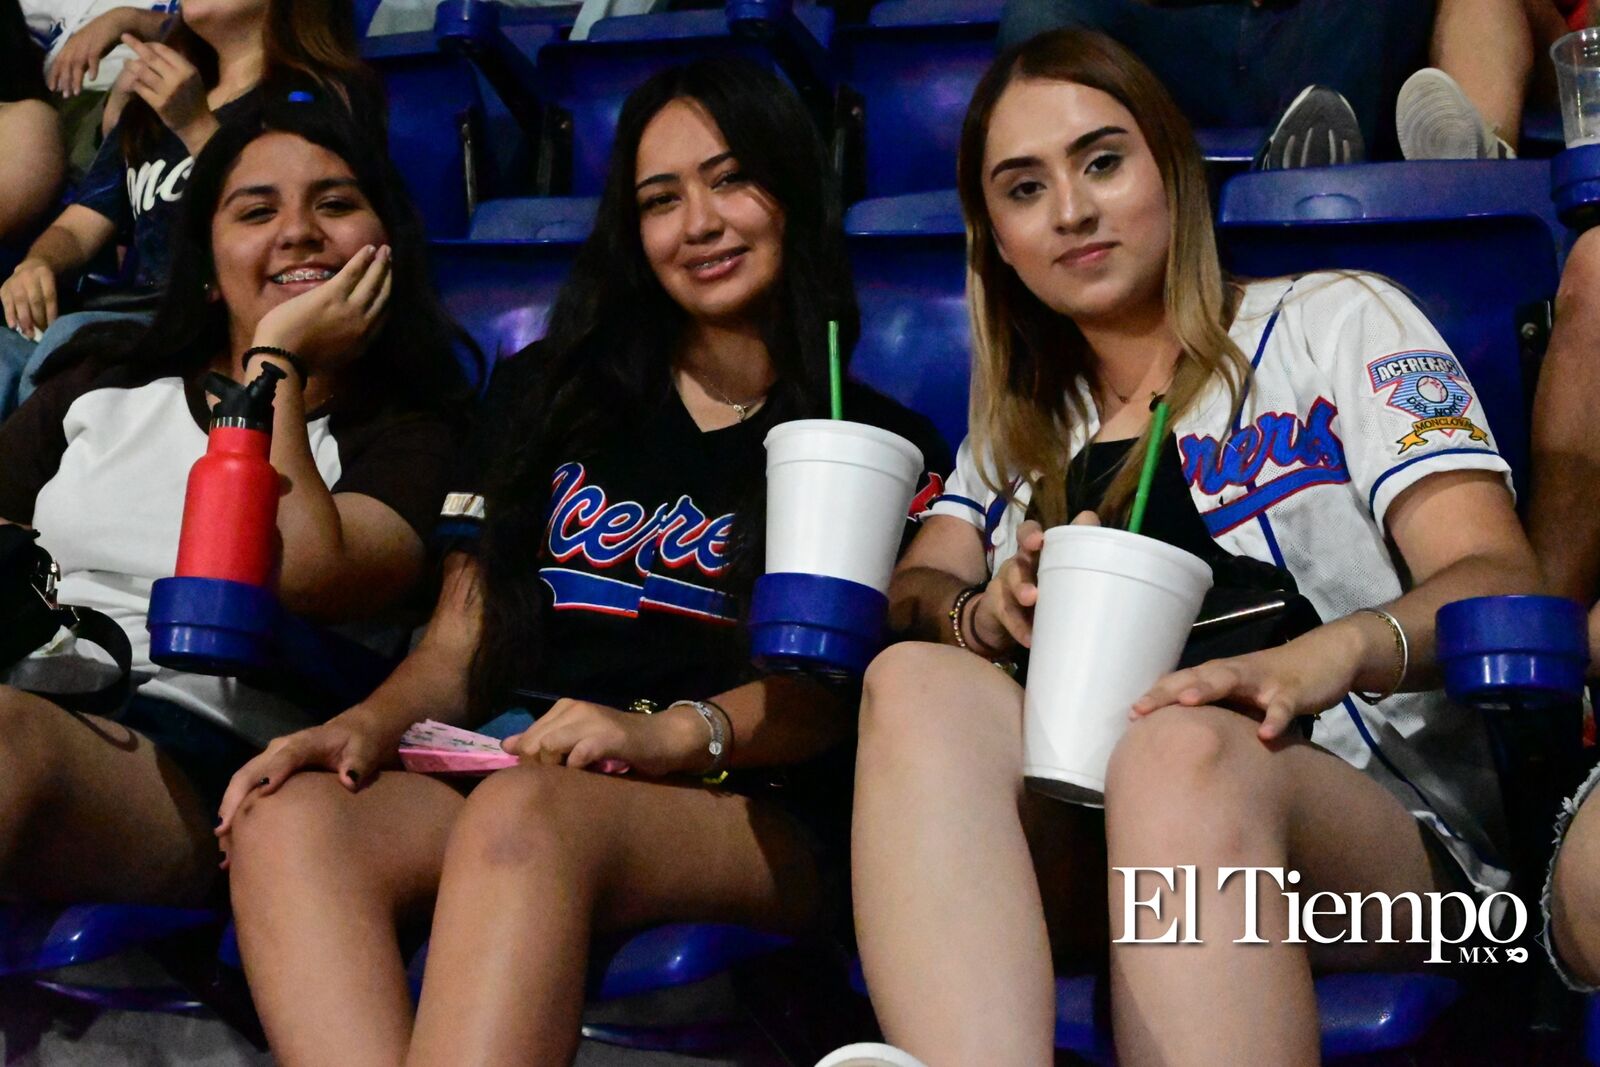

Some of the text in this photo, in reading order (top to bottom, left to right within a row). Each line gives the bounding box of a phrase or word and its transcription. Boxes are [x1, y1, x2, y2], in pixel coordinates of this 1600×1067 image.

[1376, 356, 1460, 382] ACEREROS
[1406, 393, 1464, 416] DEL NORTE
[1414, 417, 1473, 432] MONCLOVA
